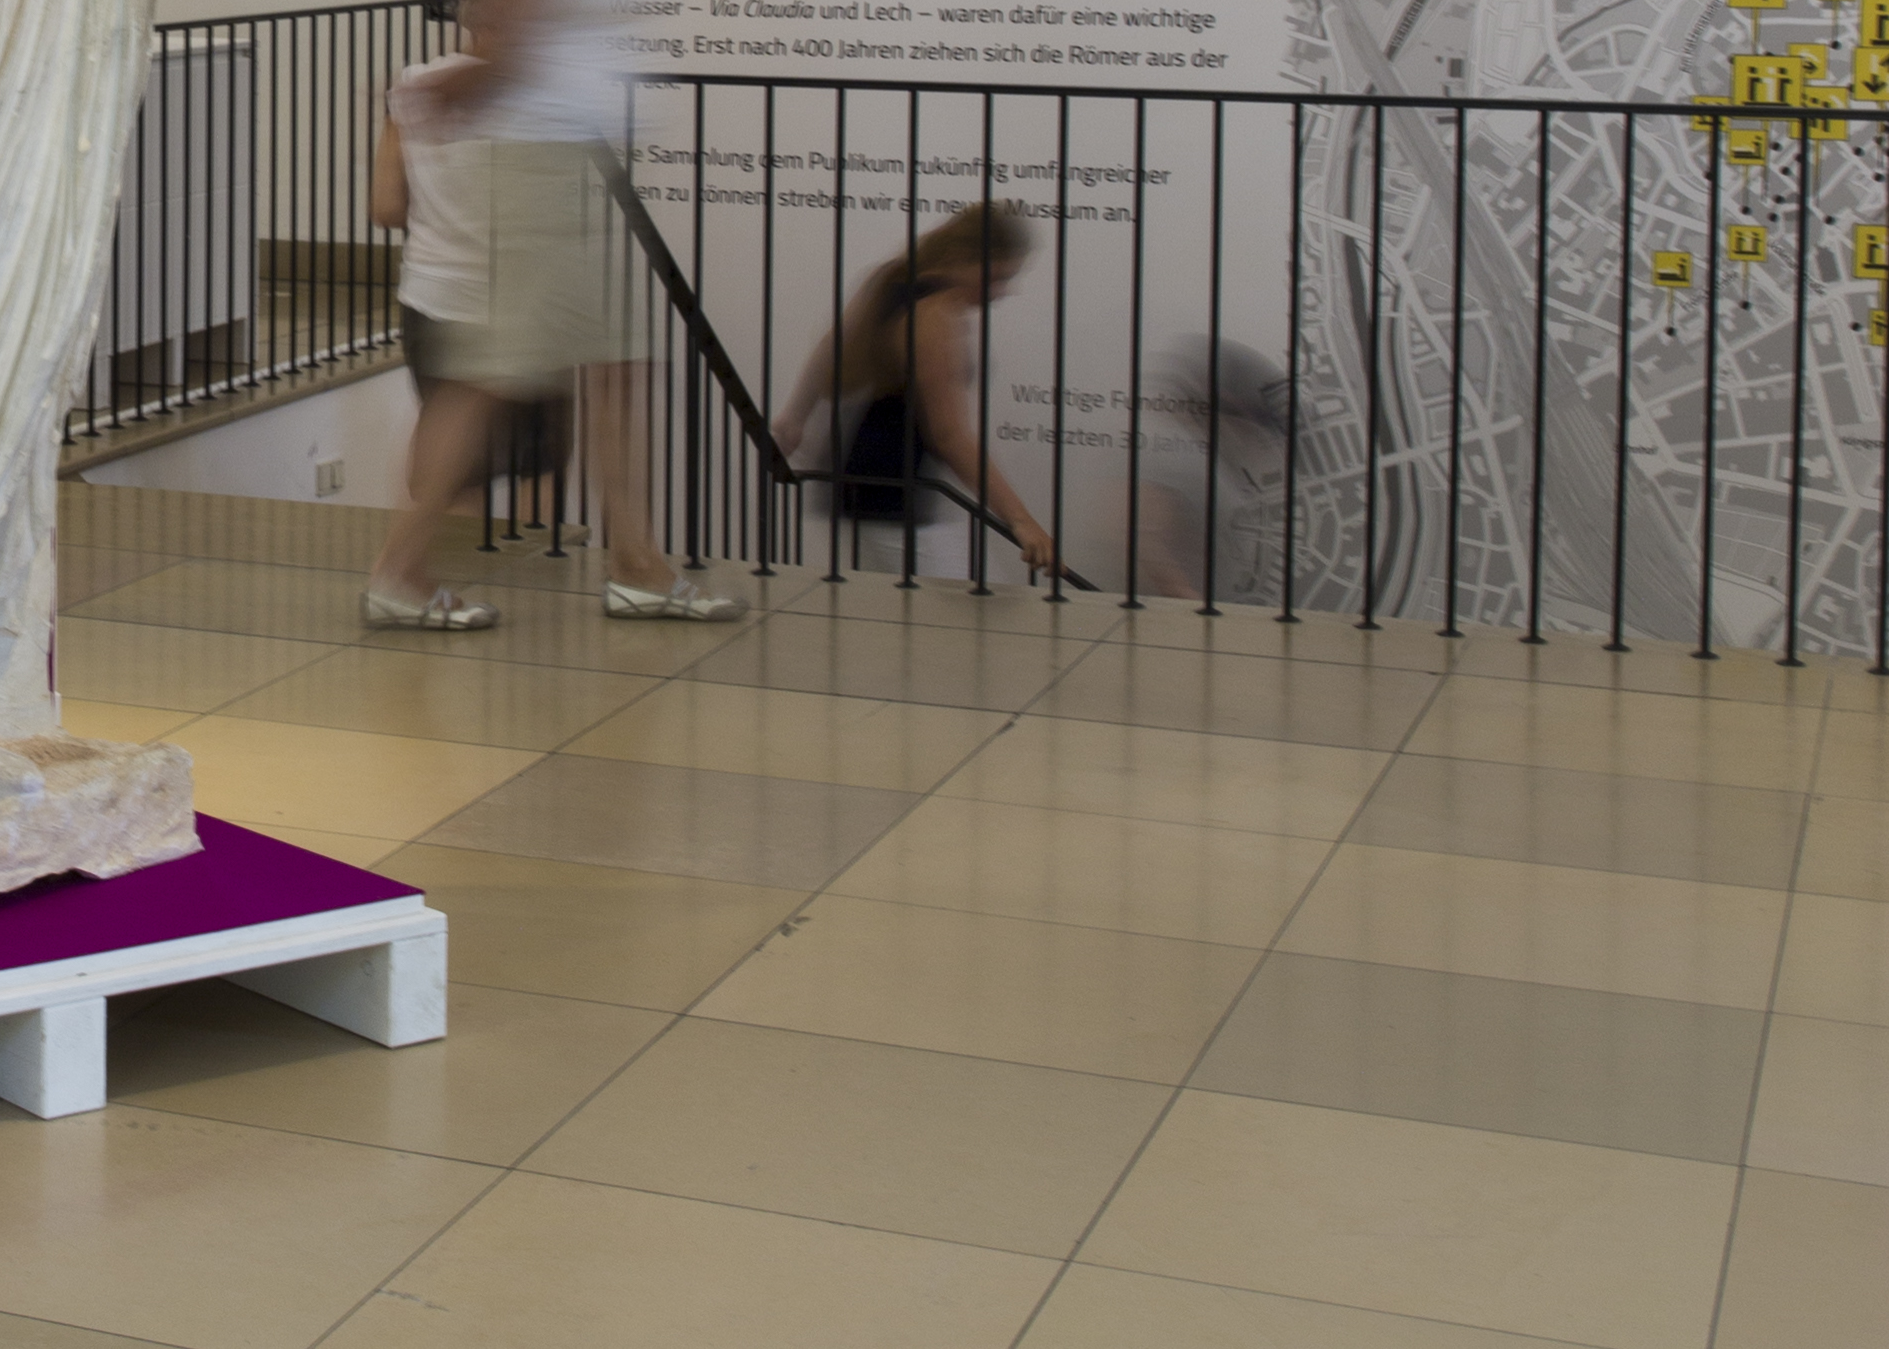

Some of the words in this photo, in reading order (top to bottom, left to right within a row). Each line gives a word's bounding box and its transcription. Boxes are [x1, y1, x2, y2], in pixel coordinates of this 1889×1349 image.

[743, 0, 816, 19] Claudia
[819, 1, 859, 21] und
[863, 2, 912, 22] Lech
[937, 7, 1004, 24] waren
[1008, 4, 1067, 26] dafür
[1071, 7, 1118, 27] eine
[1122, 7, 1217, 35] wichtige
[693, 34, 735, 55] Erst
[738, 37, 788, 57] nach
[791, 38, 834, 58] 400
[837, 39, 905, 60] Jahren
[908, 41, 978, 62] ziehen
[982, 43, 1026, 63] sich
[1030, 44, 1064, 65] die
[1068, 44, 1141, 67] Römer
[1145, 51, 1186, 68] aus
[1190, 48, 1229, 69] der
[665, 186, 690, 202] zu
[860, 192, 895, 211] wir
[996, 421, 1033, 442] der
